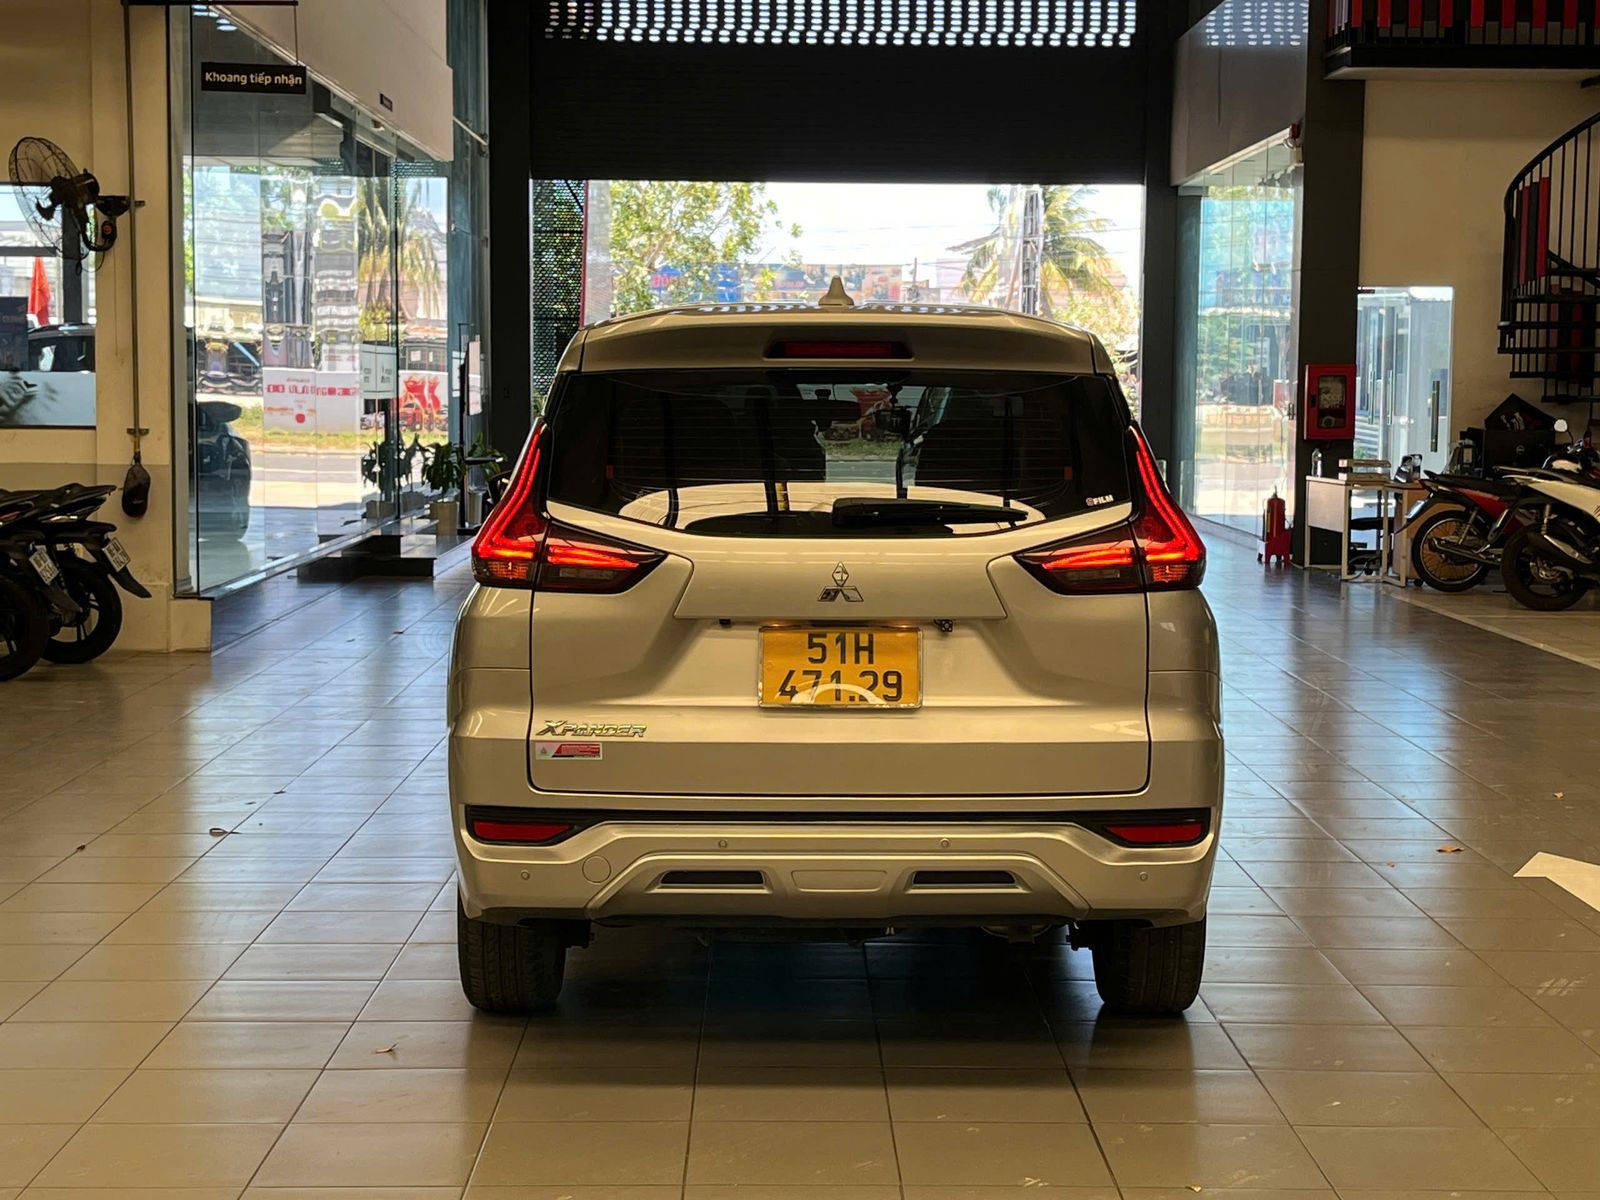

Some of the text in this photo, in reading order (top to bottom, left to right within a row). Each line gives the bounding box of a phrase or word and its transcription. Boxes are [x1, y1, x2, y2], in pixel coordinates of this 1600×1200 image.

[205, 72, 303, 87] Khoang tiếp nhận
[807, 632, 875, 665] 51H
[778, 669, 903, 703] 471.29
[536, 720, 648, 738] XPANDER
